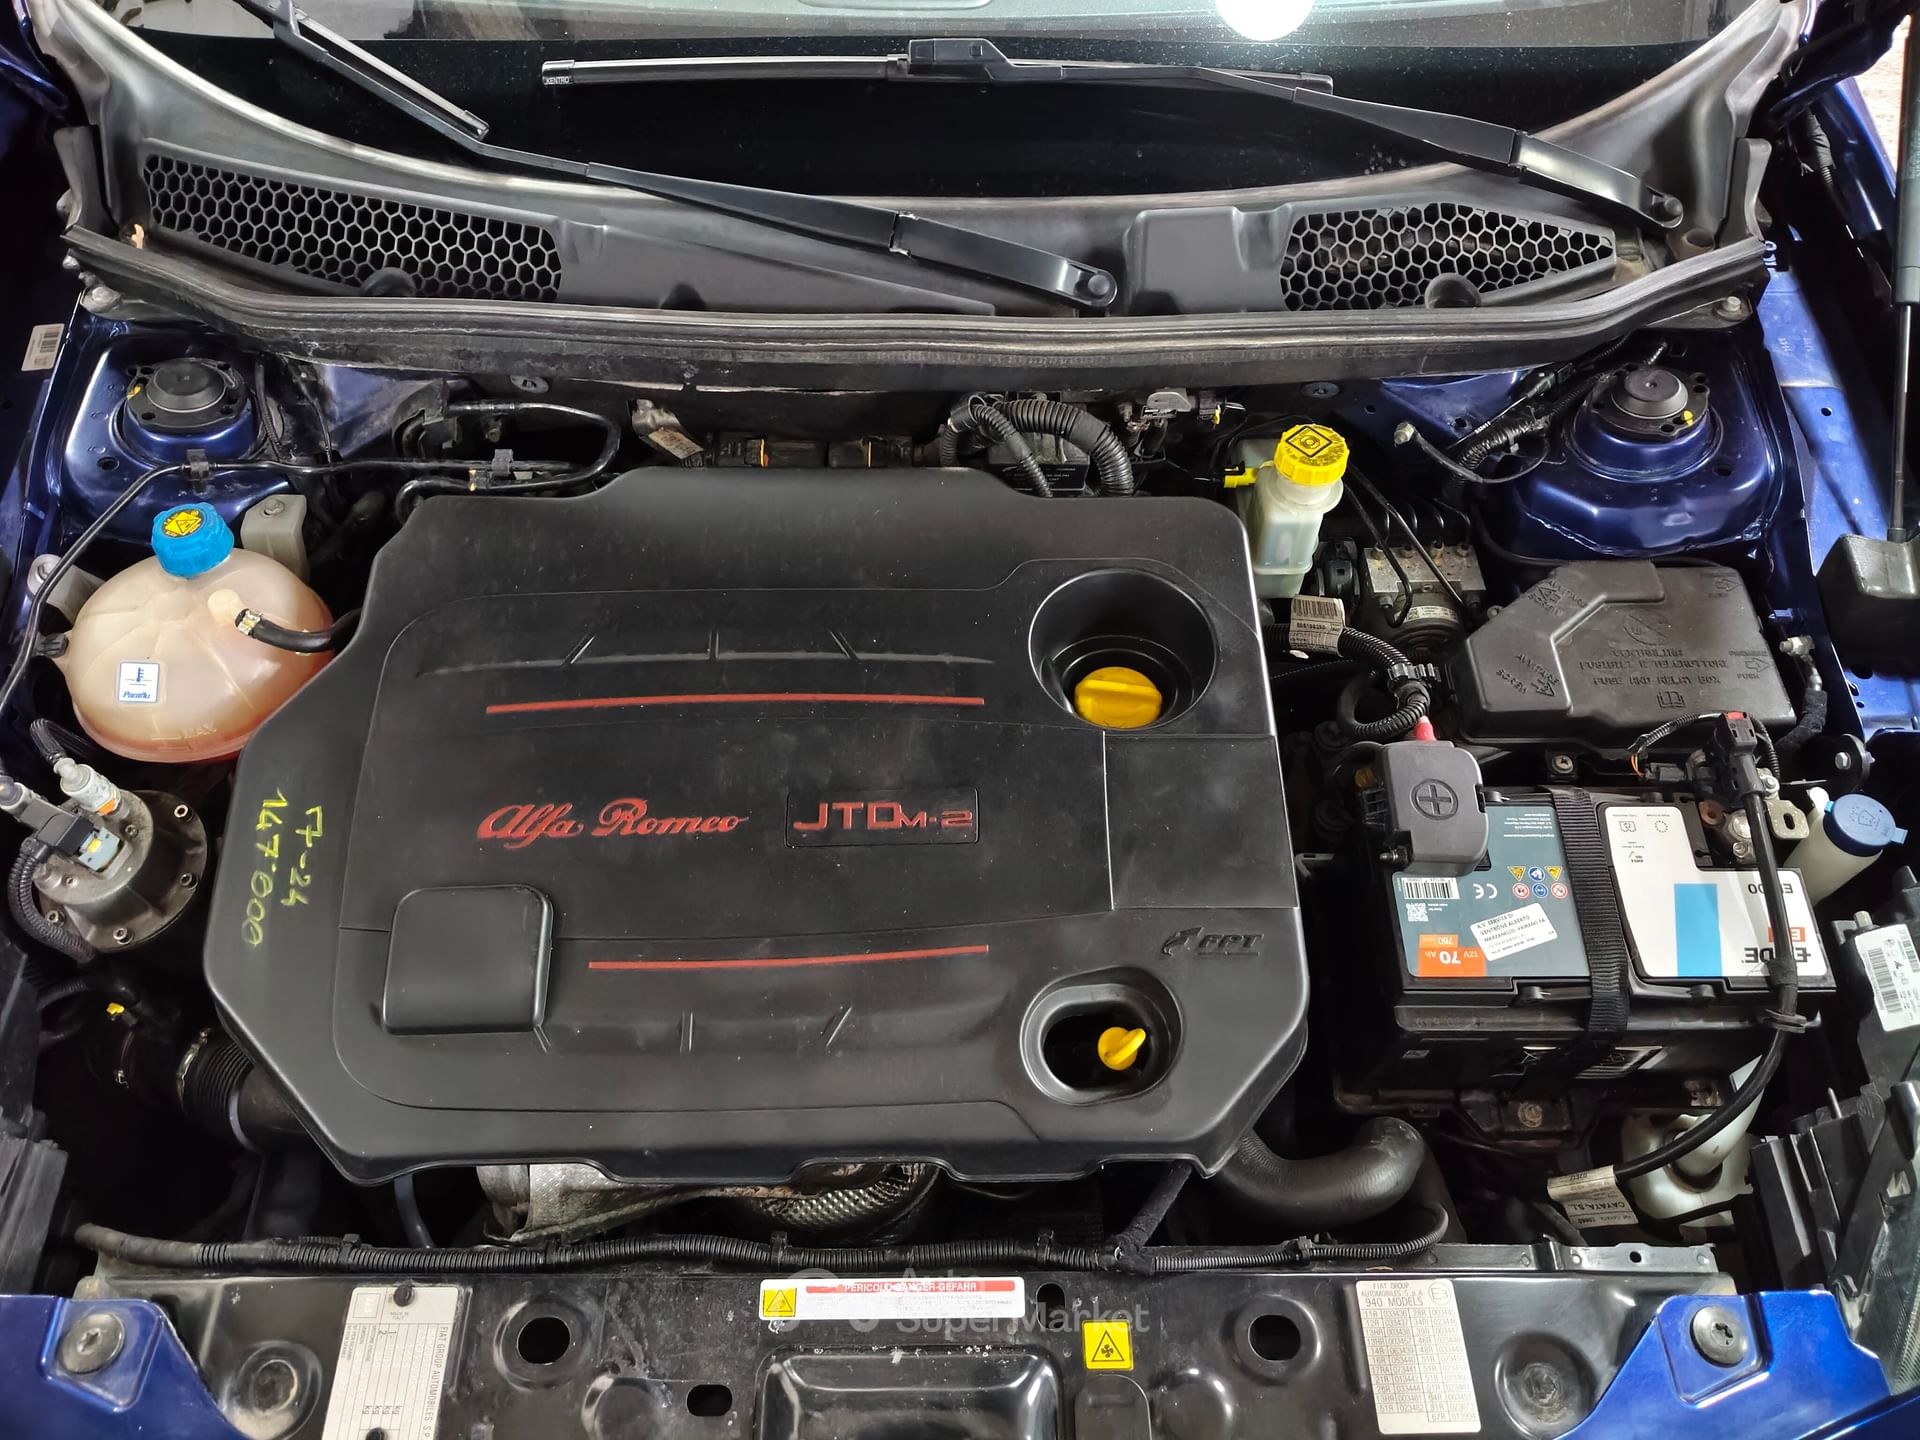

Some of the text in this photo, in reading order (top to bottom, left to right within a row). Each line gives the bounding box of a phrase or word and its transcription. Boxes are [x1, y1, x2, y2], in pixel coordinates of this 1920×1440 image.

[476, 798, 749, 849] Alfa Romeo
[1439, 950, 1462, 965] 70
[1365, 1296, 1424, 1307] 940 MODELS
[437, 1326, 448, 1338] FIAT
[434, 1343, 446, 1368] GROUP
[424, 1370, 440, 1421] AUTOMOBILES
